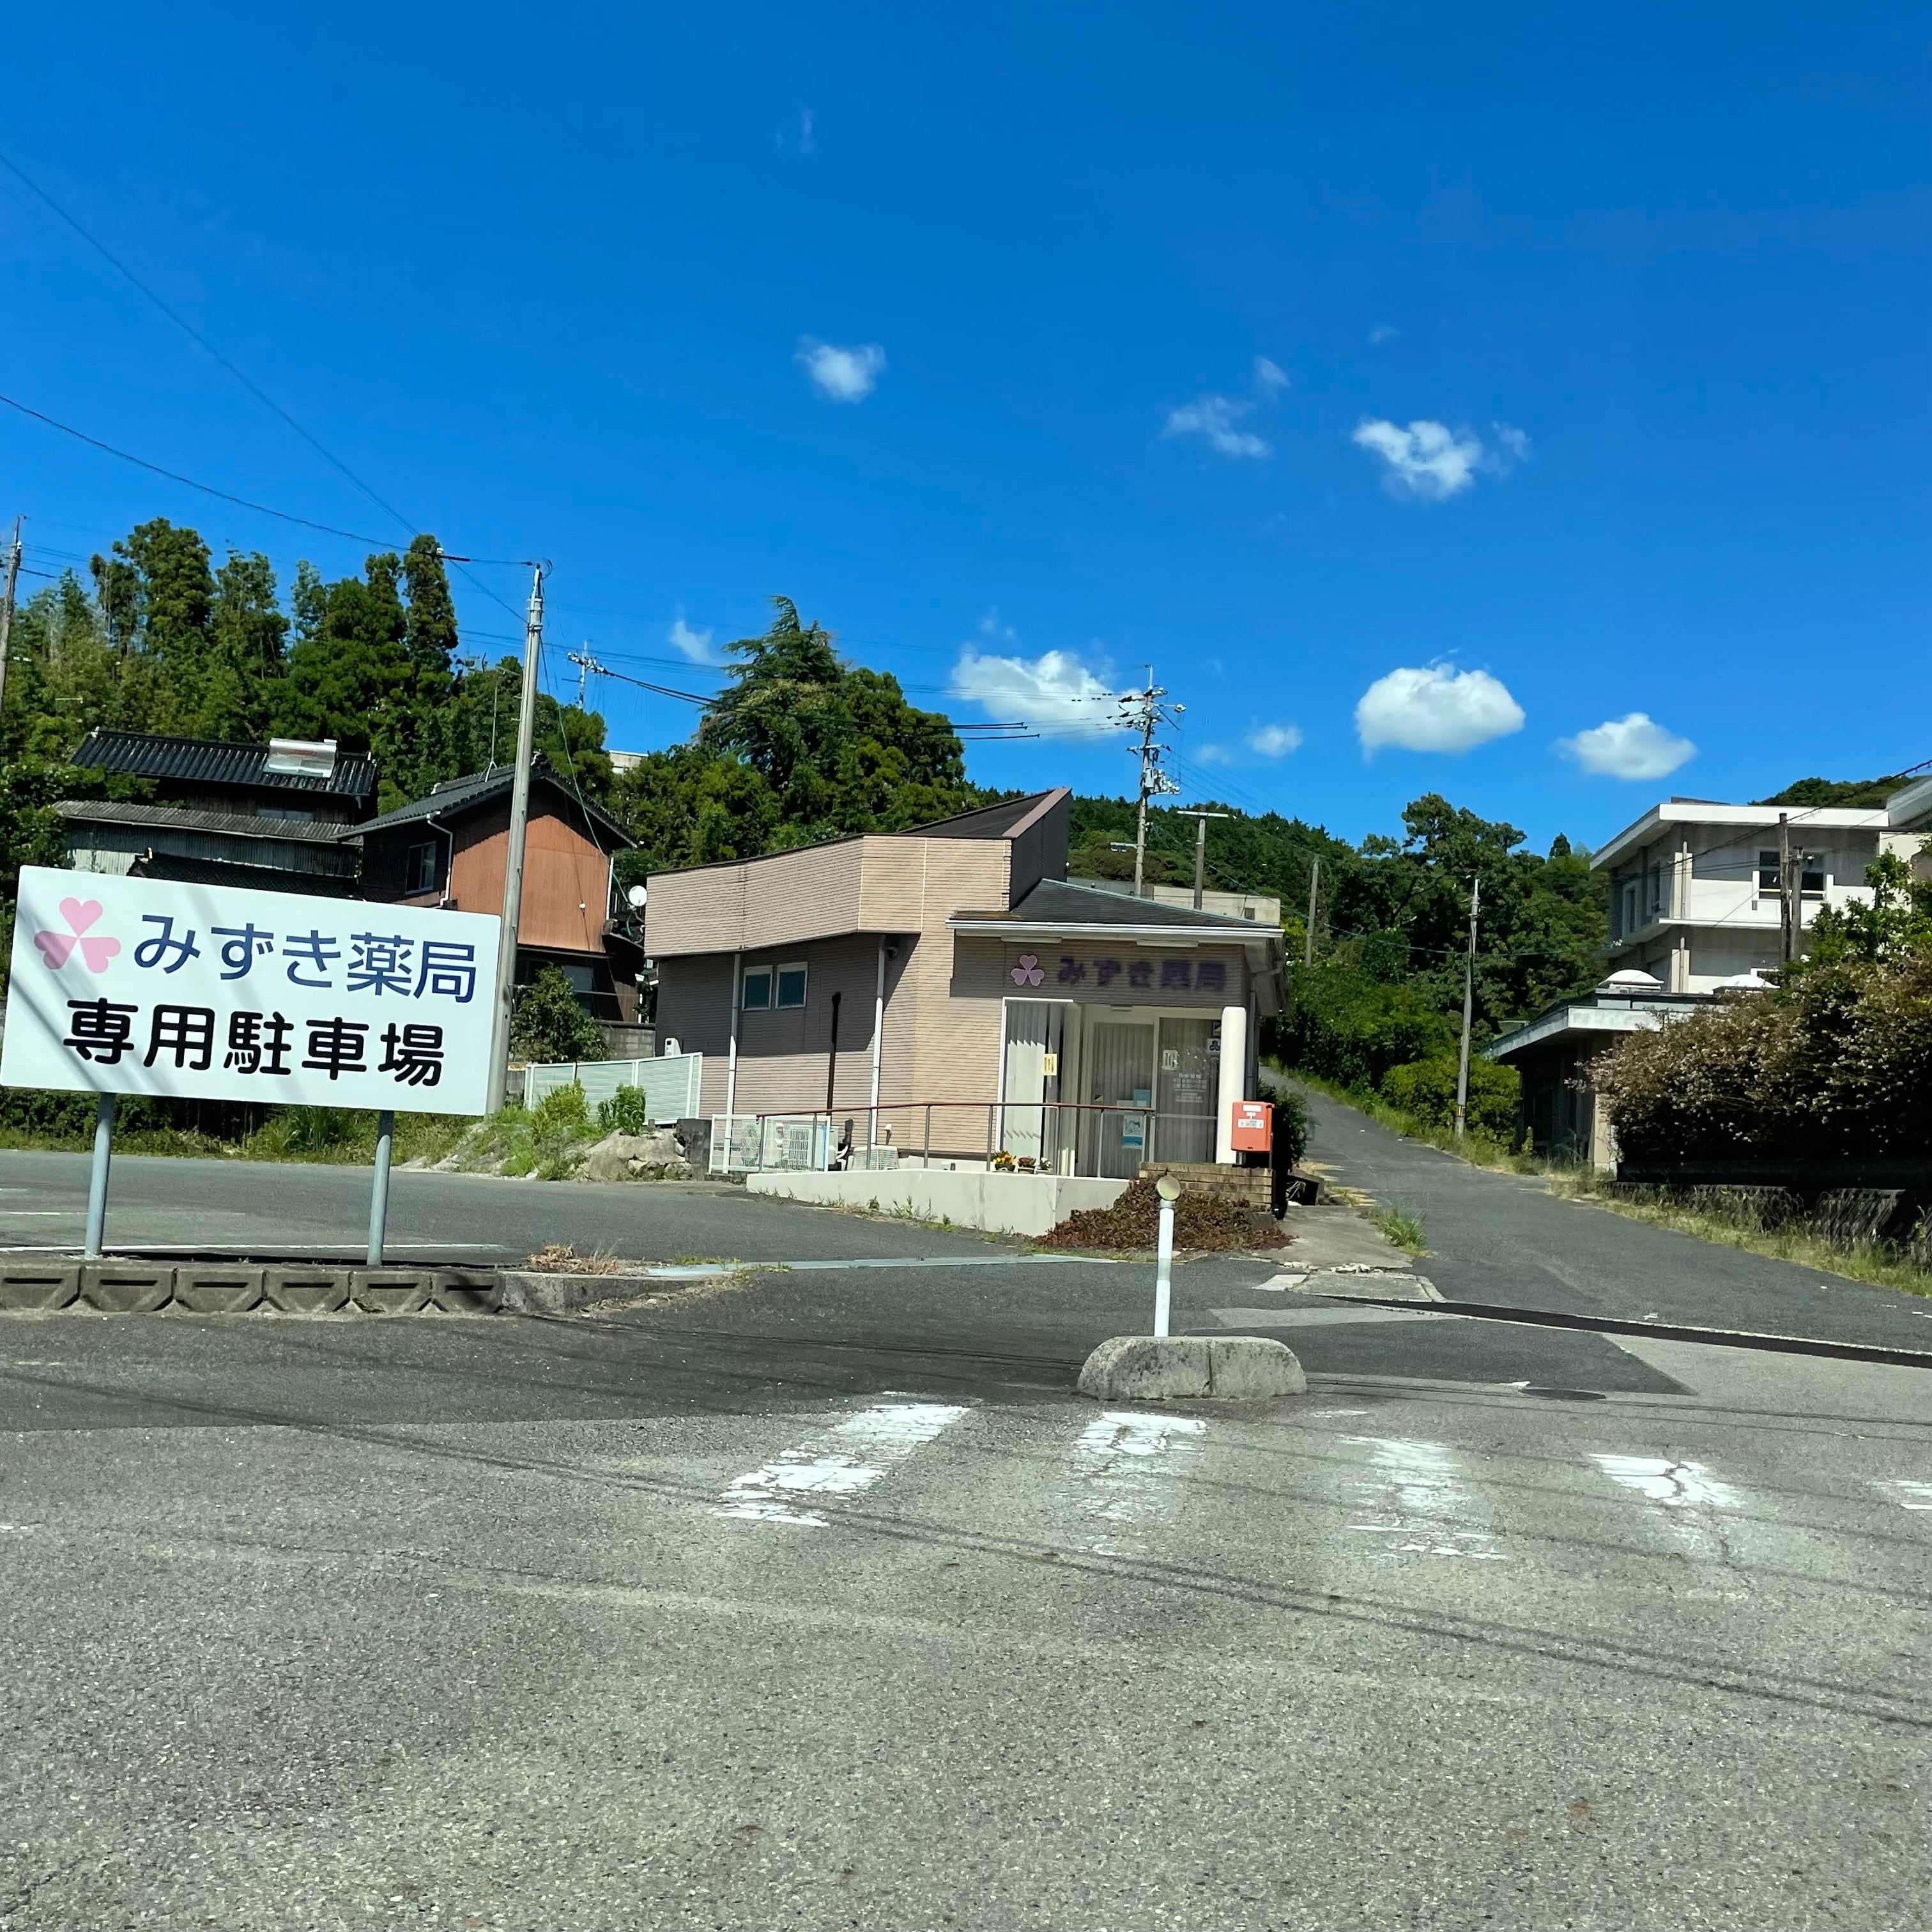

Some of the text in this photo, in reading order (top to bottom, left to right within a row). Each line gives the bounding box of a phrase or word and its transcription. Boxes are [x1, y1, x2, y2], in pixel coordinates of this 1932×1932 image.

[134, 914, 477, 1003] みずき薬局
[63, 997, 445, 1087] 専用駐車場
